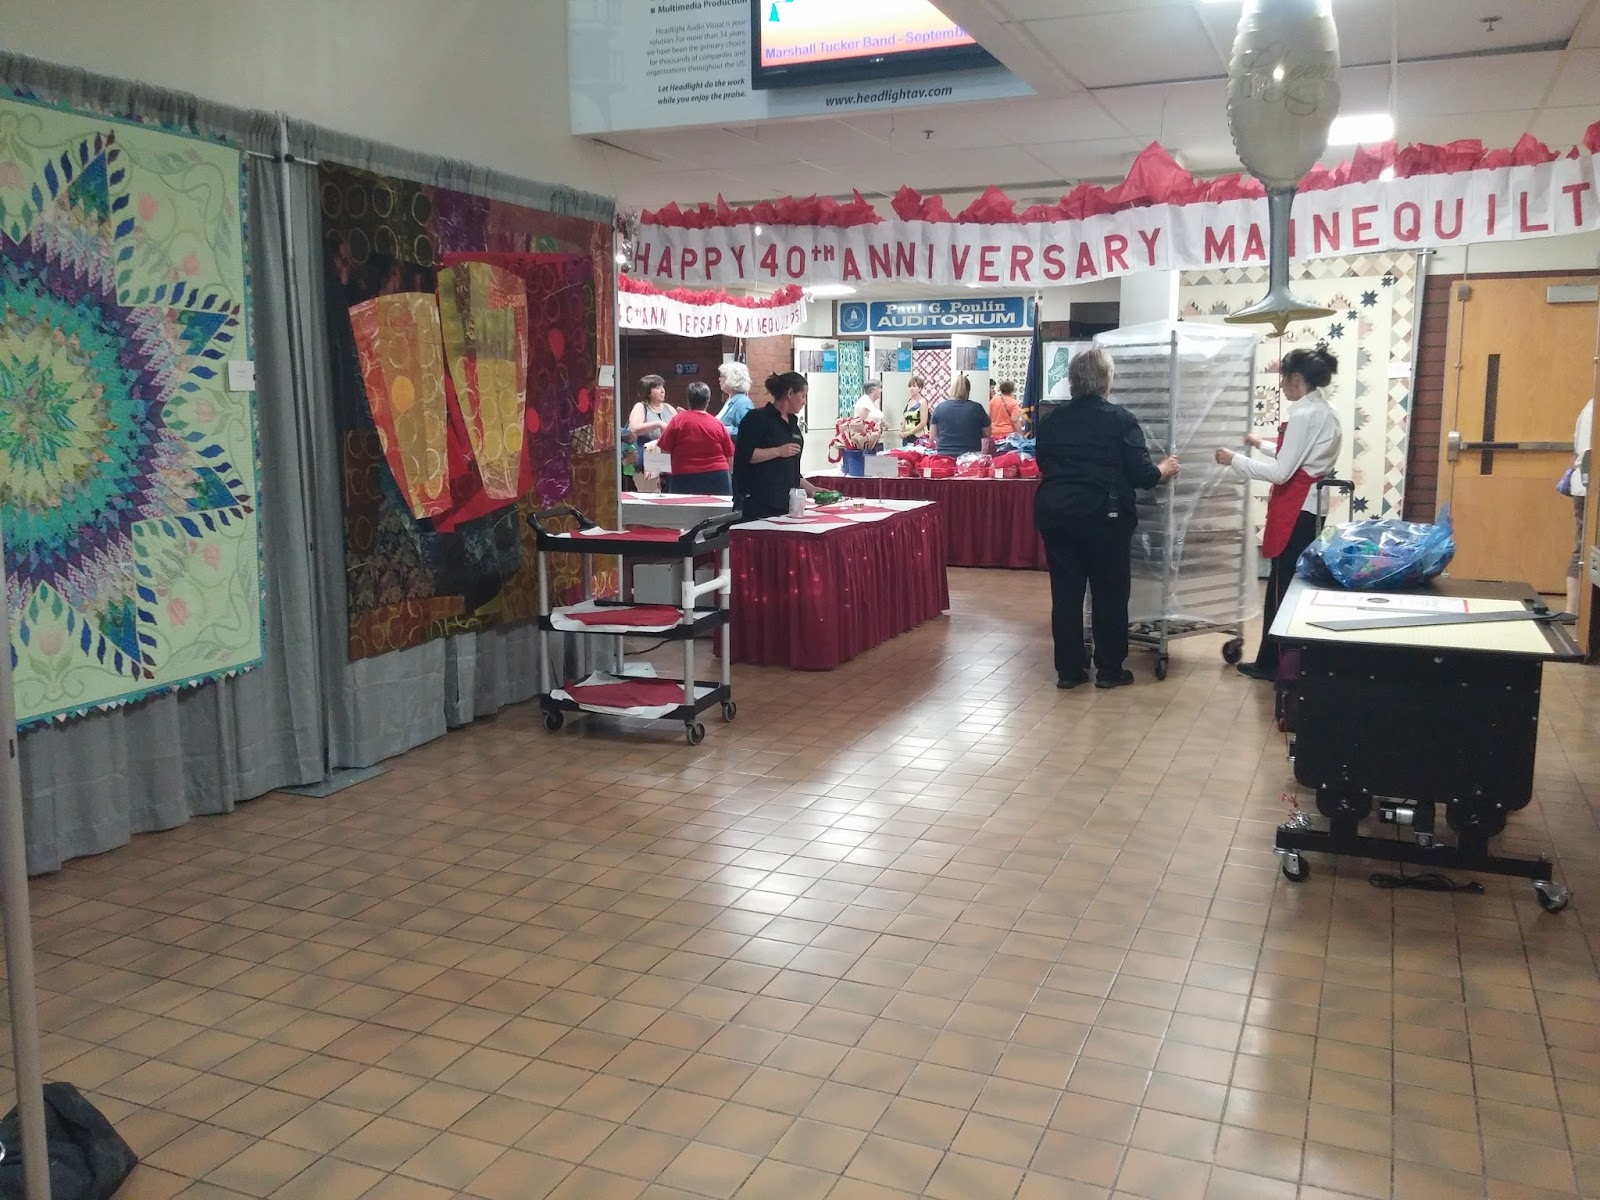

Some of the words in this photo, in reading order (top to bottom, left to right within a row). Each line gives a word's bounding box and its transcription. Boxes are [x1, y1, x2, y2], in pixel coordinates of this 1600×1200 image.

[658, 2, 702, 13] Multimedia
[655, 25, 685, 35] Headlight
[687, 23, 705, 31] Audio
[732, 20, 746, 28] your
[700, 42, 724, 51] primary
[765, 43, 816, 59] Marshall
[819, 38, 860, 53] Tucker
[863, 33, 896, 48] Band
[659, 55, 691, 65] thousands
[733, 49, 746, 57] and
[646, 67, 687, 77] organizations
[688, 62, 724, 72] throughout
[658, 85, 669, 93] Let
[669, 81, 703, 92] Headlight
[704, 80, 714, 88] do
[714, 79, 726, 87] the
[727, 77, 745, 86] work
[658, 96, 675, 105] while
[676, 96, 690, 105] you
[690, 93, 709, 103] enjoy
[710, 91, 722, 100] the
[723, 90, 746, 100] praise.
[825, 85, 953, 106] www.headlightav.com
[634, 241, 746, 280] HAPPY
[842, 227, 1162, 282] ANNIVERSARY
[885, 303, 923, 315] Paul
[928, 302, 945, 314] G.
[950, 300, 1006, 313] Poulin
[877, 312, 1016, 327] AUDITORIUM
